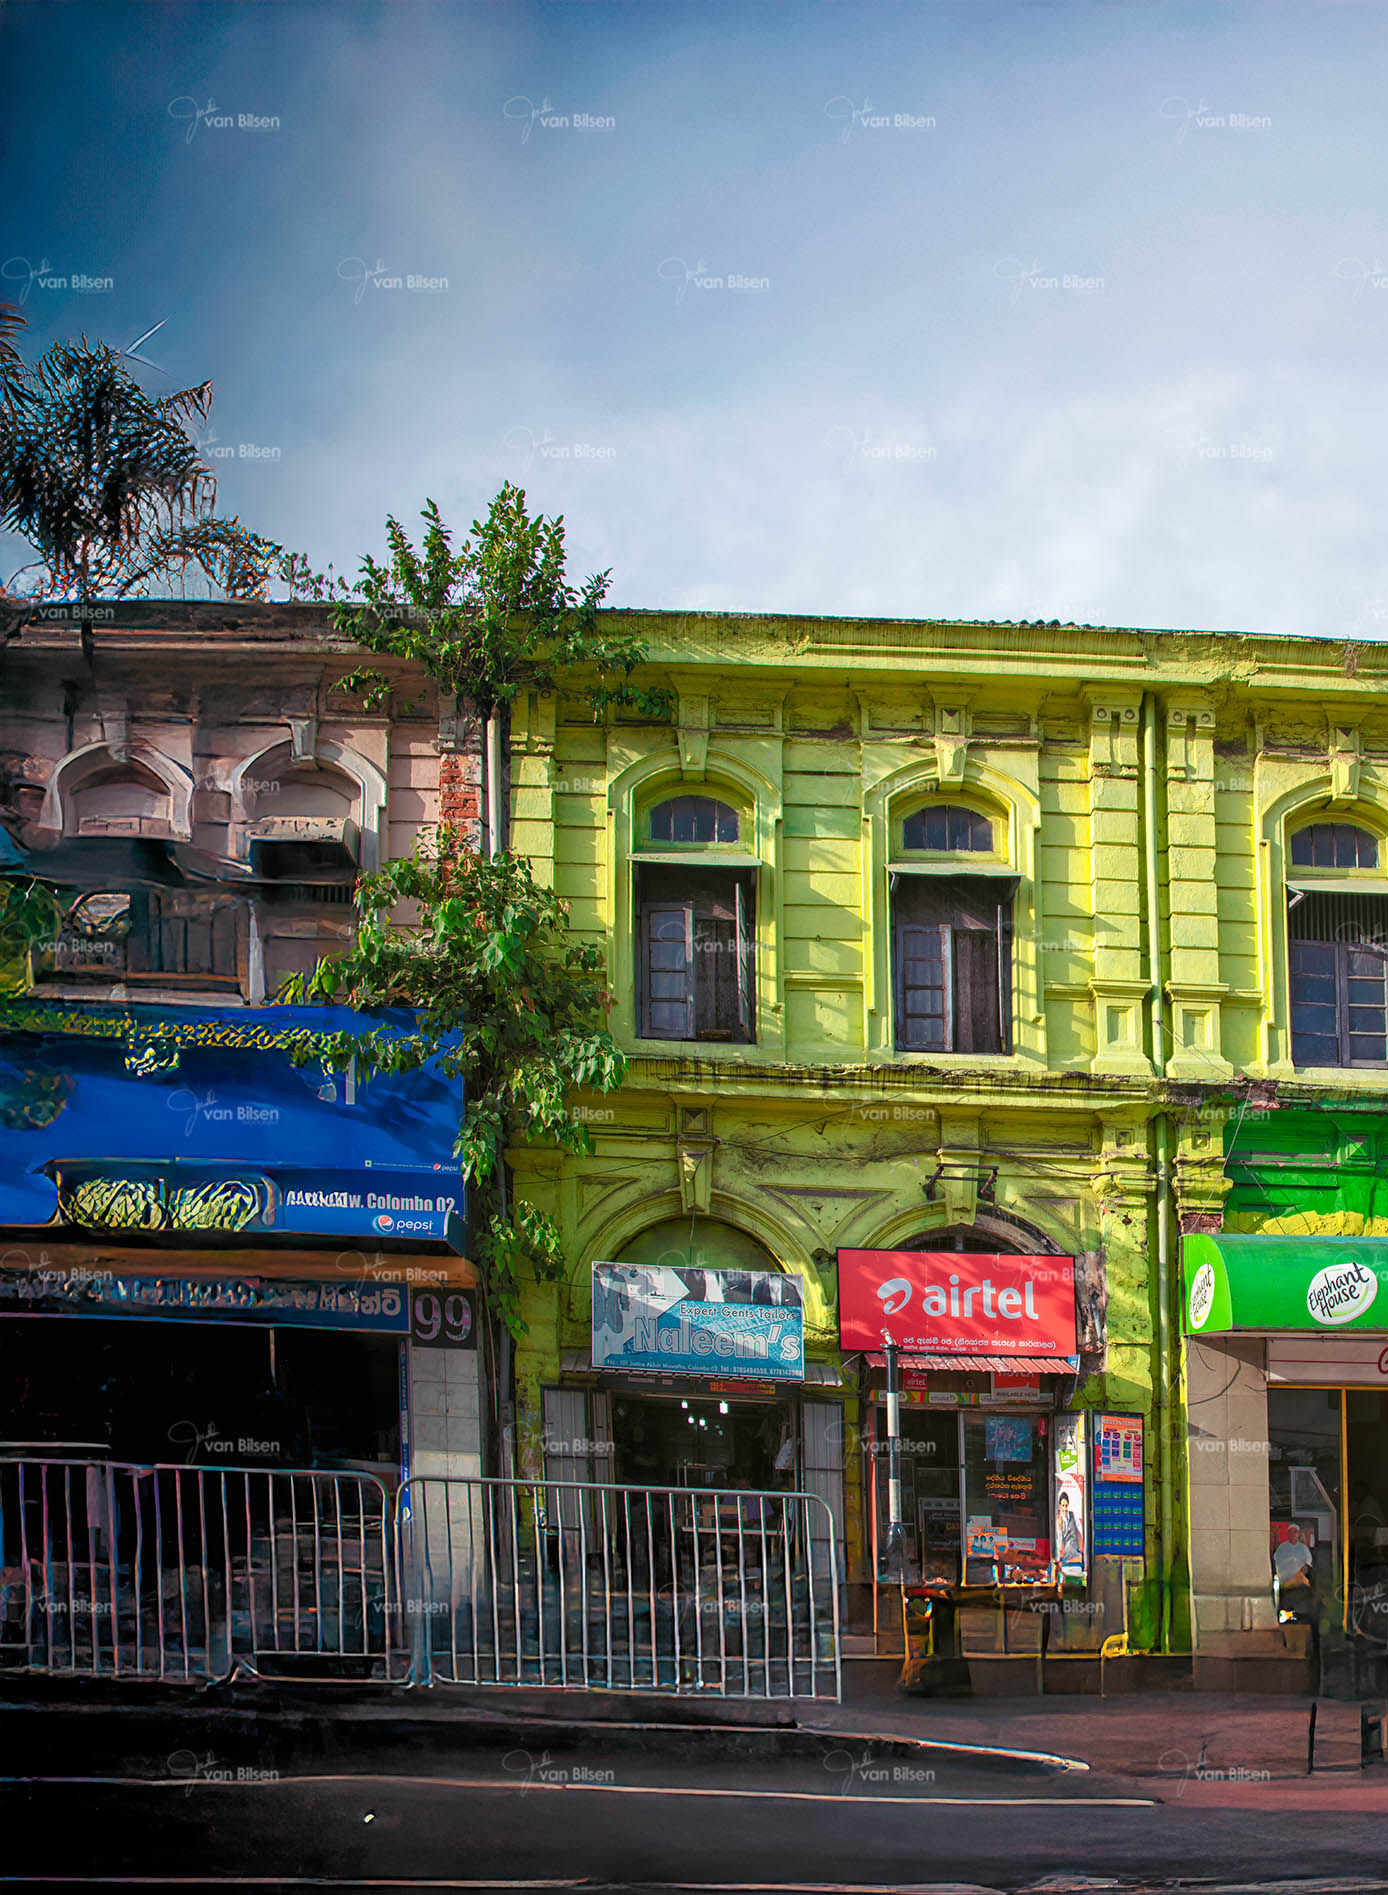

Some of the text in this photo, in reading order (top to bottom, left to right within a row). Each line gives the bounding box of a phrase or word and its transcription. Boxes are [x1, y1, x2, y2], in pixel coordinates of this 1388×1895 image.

[396, 1219, 434, 1232] pepsi
[922, 1274, 1039, 1320] airtel
[1308, 1261, 1370, 1311] Elephant
[1319, 1284, 1360, 1318] House
[414, 1293, 472, 1341] 99
[680, 1303, 797, 1321] Expert Gents Tailors
[633, 1315, 801, 1361] Naleem's
